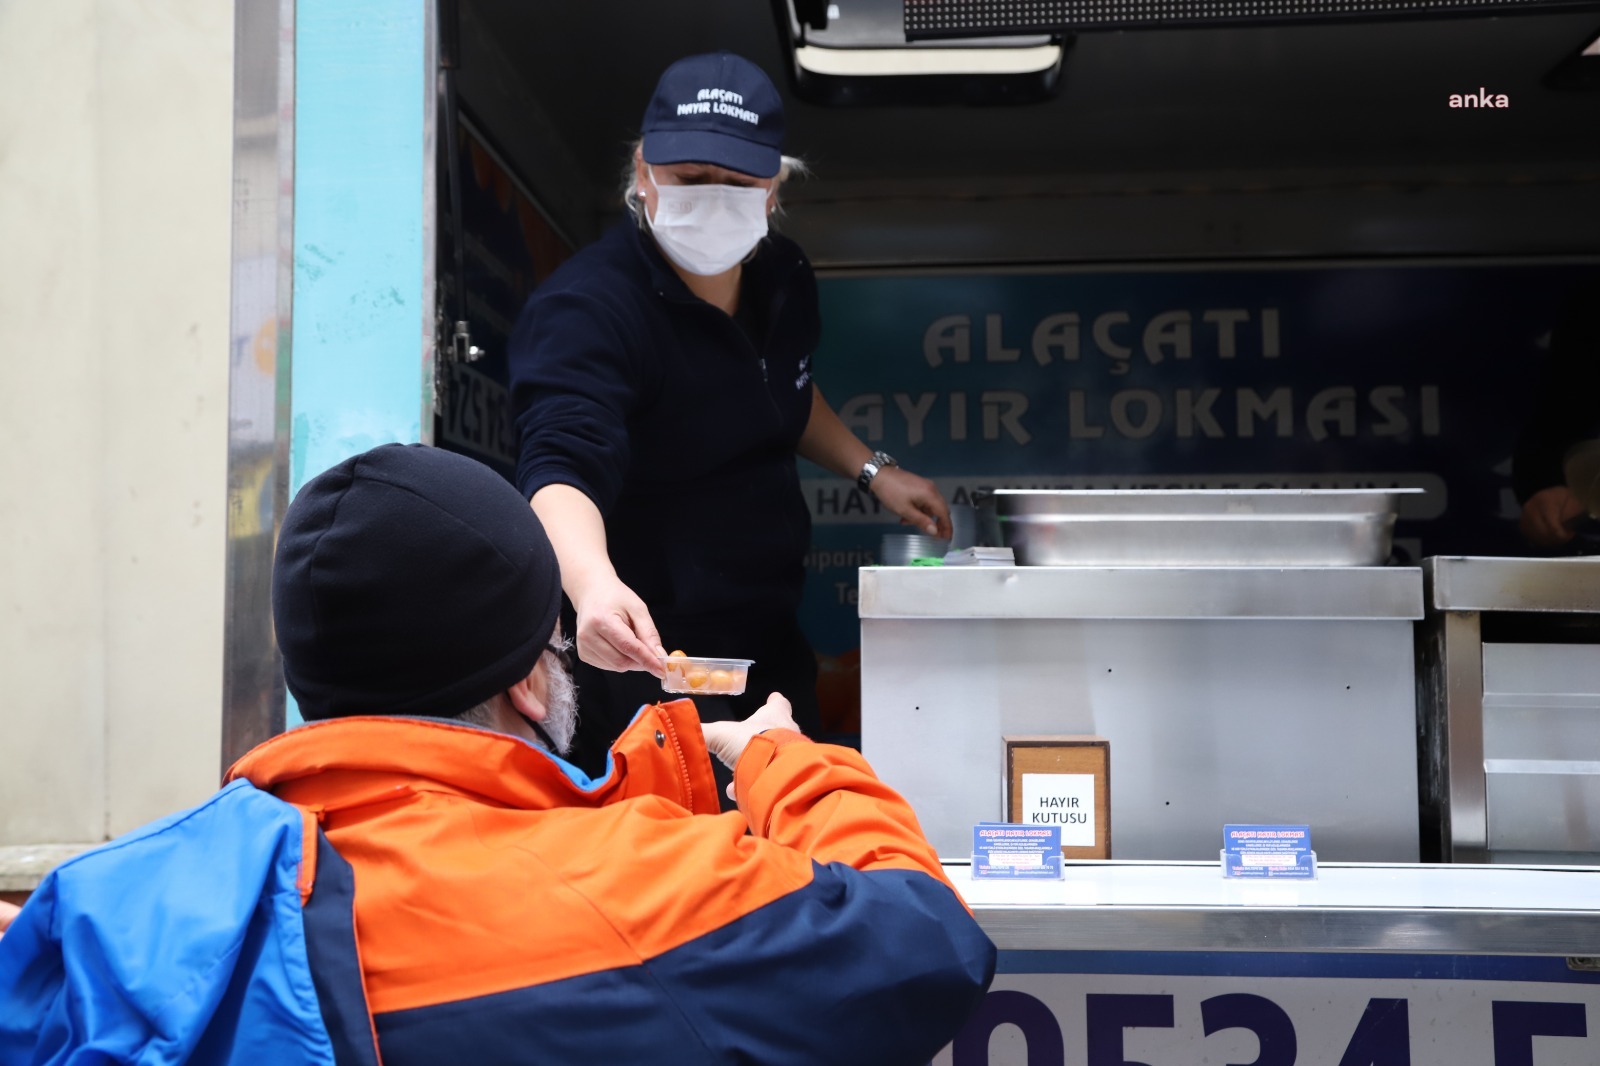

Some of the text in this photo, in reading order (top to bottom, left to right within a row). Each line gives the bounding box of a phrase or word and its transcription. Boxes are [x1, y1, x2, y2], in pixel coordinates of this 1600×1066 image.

[697, 88, 743, 105] ALAÇATI
[677, 102, 759, 125] HAYIR LOKMASI
[923, 308, 1281, 375] ALAÇATI
[838, 385, 1441, 447] AYIR LOKMASI
[1040, 797, 1080, 808] HAYIR
[1032, 812, 1087, 824] KUTUSU
